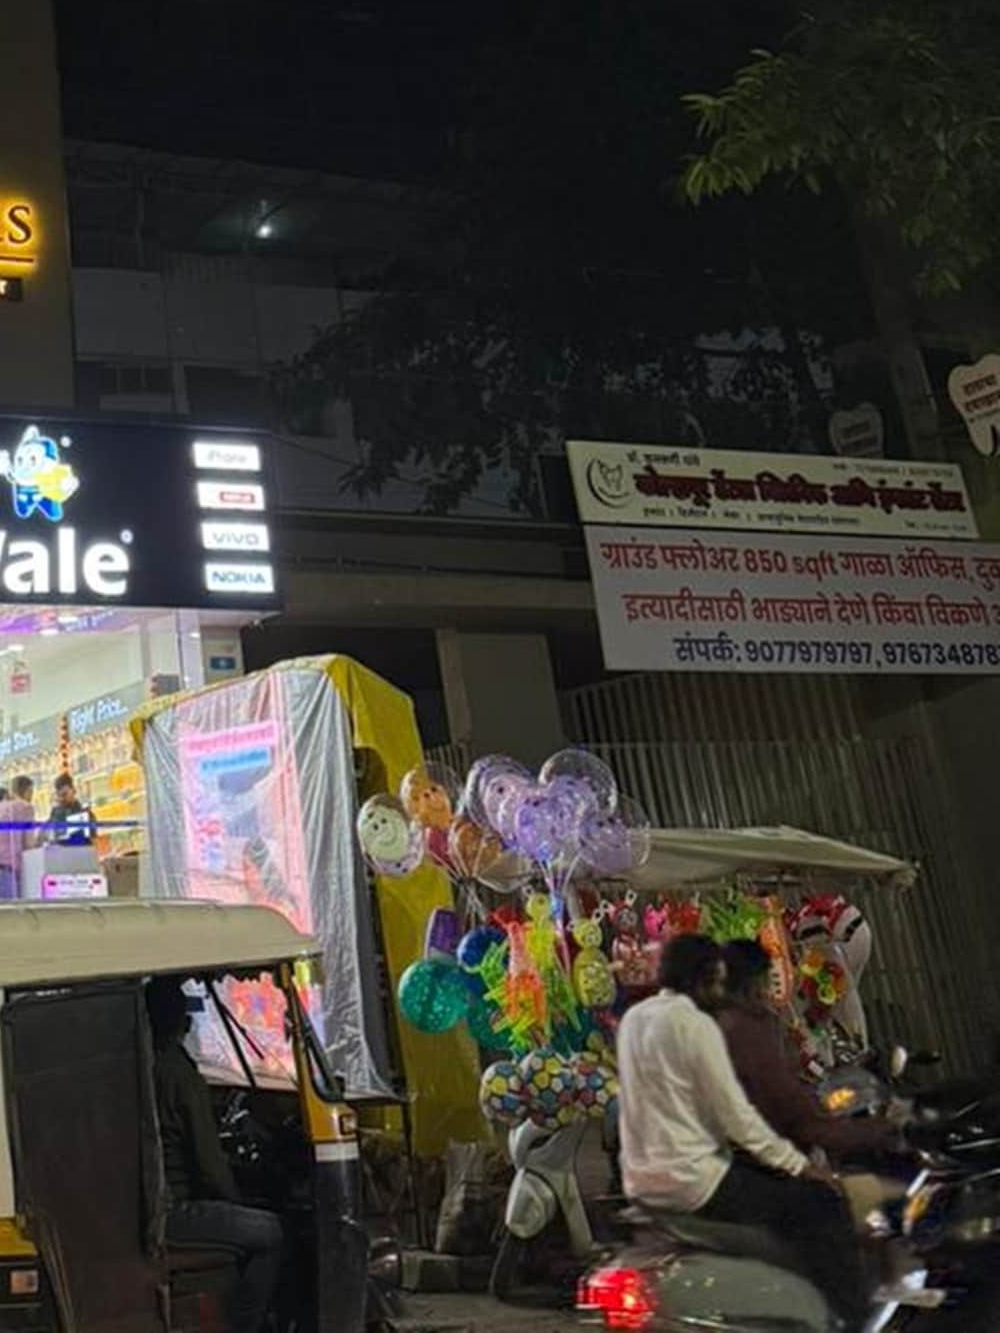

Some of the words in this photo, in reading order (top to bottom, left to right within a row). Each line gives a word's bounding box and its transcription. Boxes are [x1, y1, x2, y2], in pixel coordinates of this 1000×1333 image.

[660, 538, 740, 572] फ्लोअर
[743, 548, 787, 574] 850
[838, 552, 895, 577] गाळा
[211, 570, 266, 585] NOKIA
[621, 586, 746, 622] इत्यादीसाठी
[834, 592, 870, 624] देणे
[873, 591, 925, 625] किंवा
[926, 592, 990, 626] विकणे
